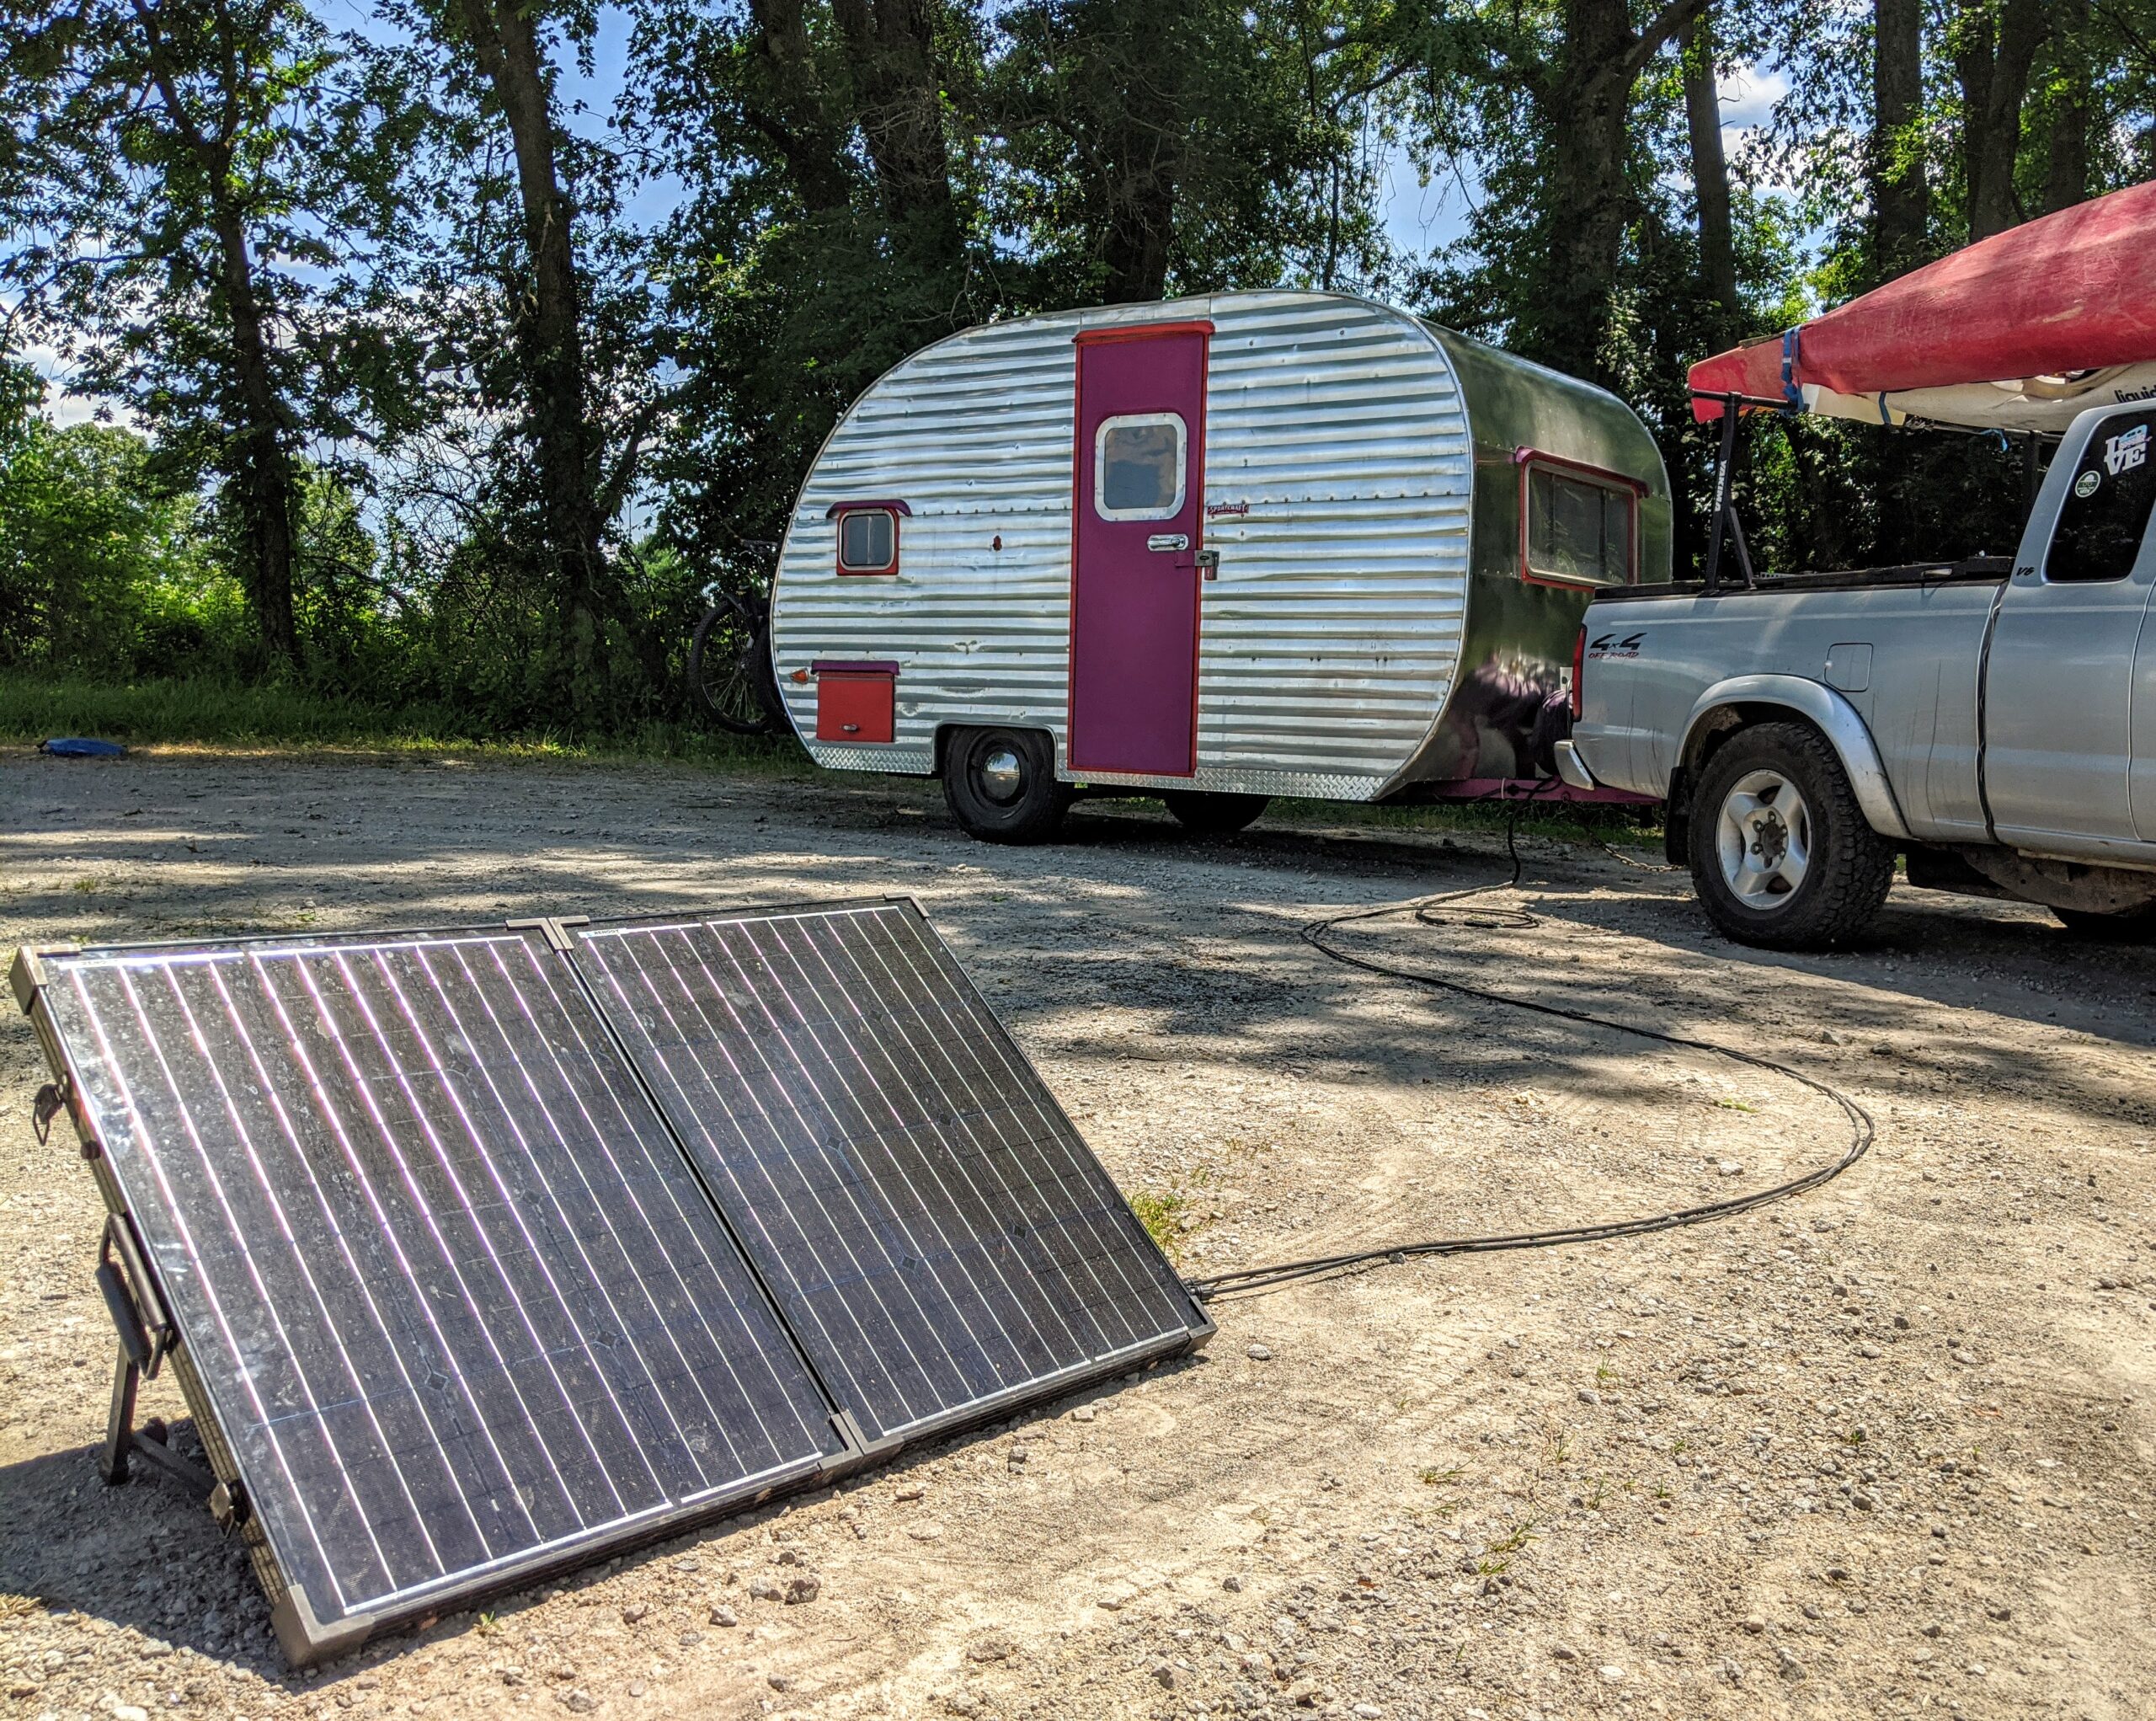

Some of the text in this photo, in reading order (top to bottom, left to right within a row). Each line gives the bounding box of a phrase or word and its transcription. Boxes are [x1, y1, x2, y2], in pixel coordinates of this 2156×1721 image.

[1715, 459, 1727, 511] YAKIMA
[1209, 505, 1246, 514] SPORTCRAFT
[2016, 567, 2035, 576] V6
[1590, 633, 1647, 650] 4x4
